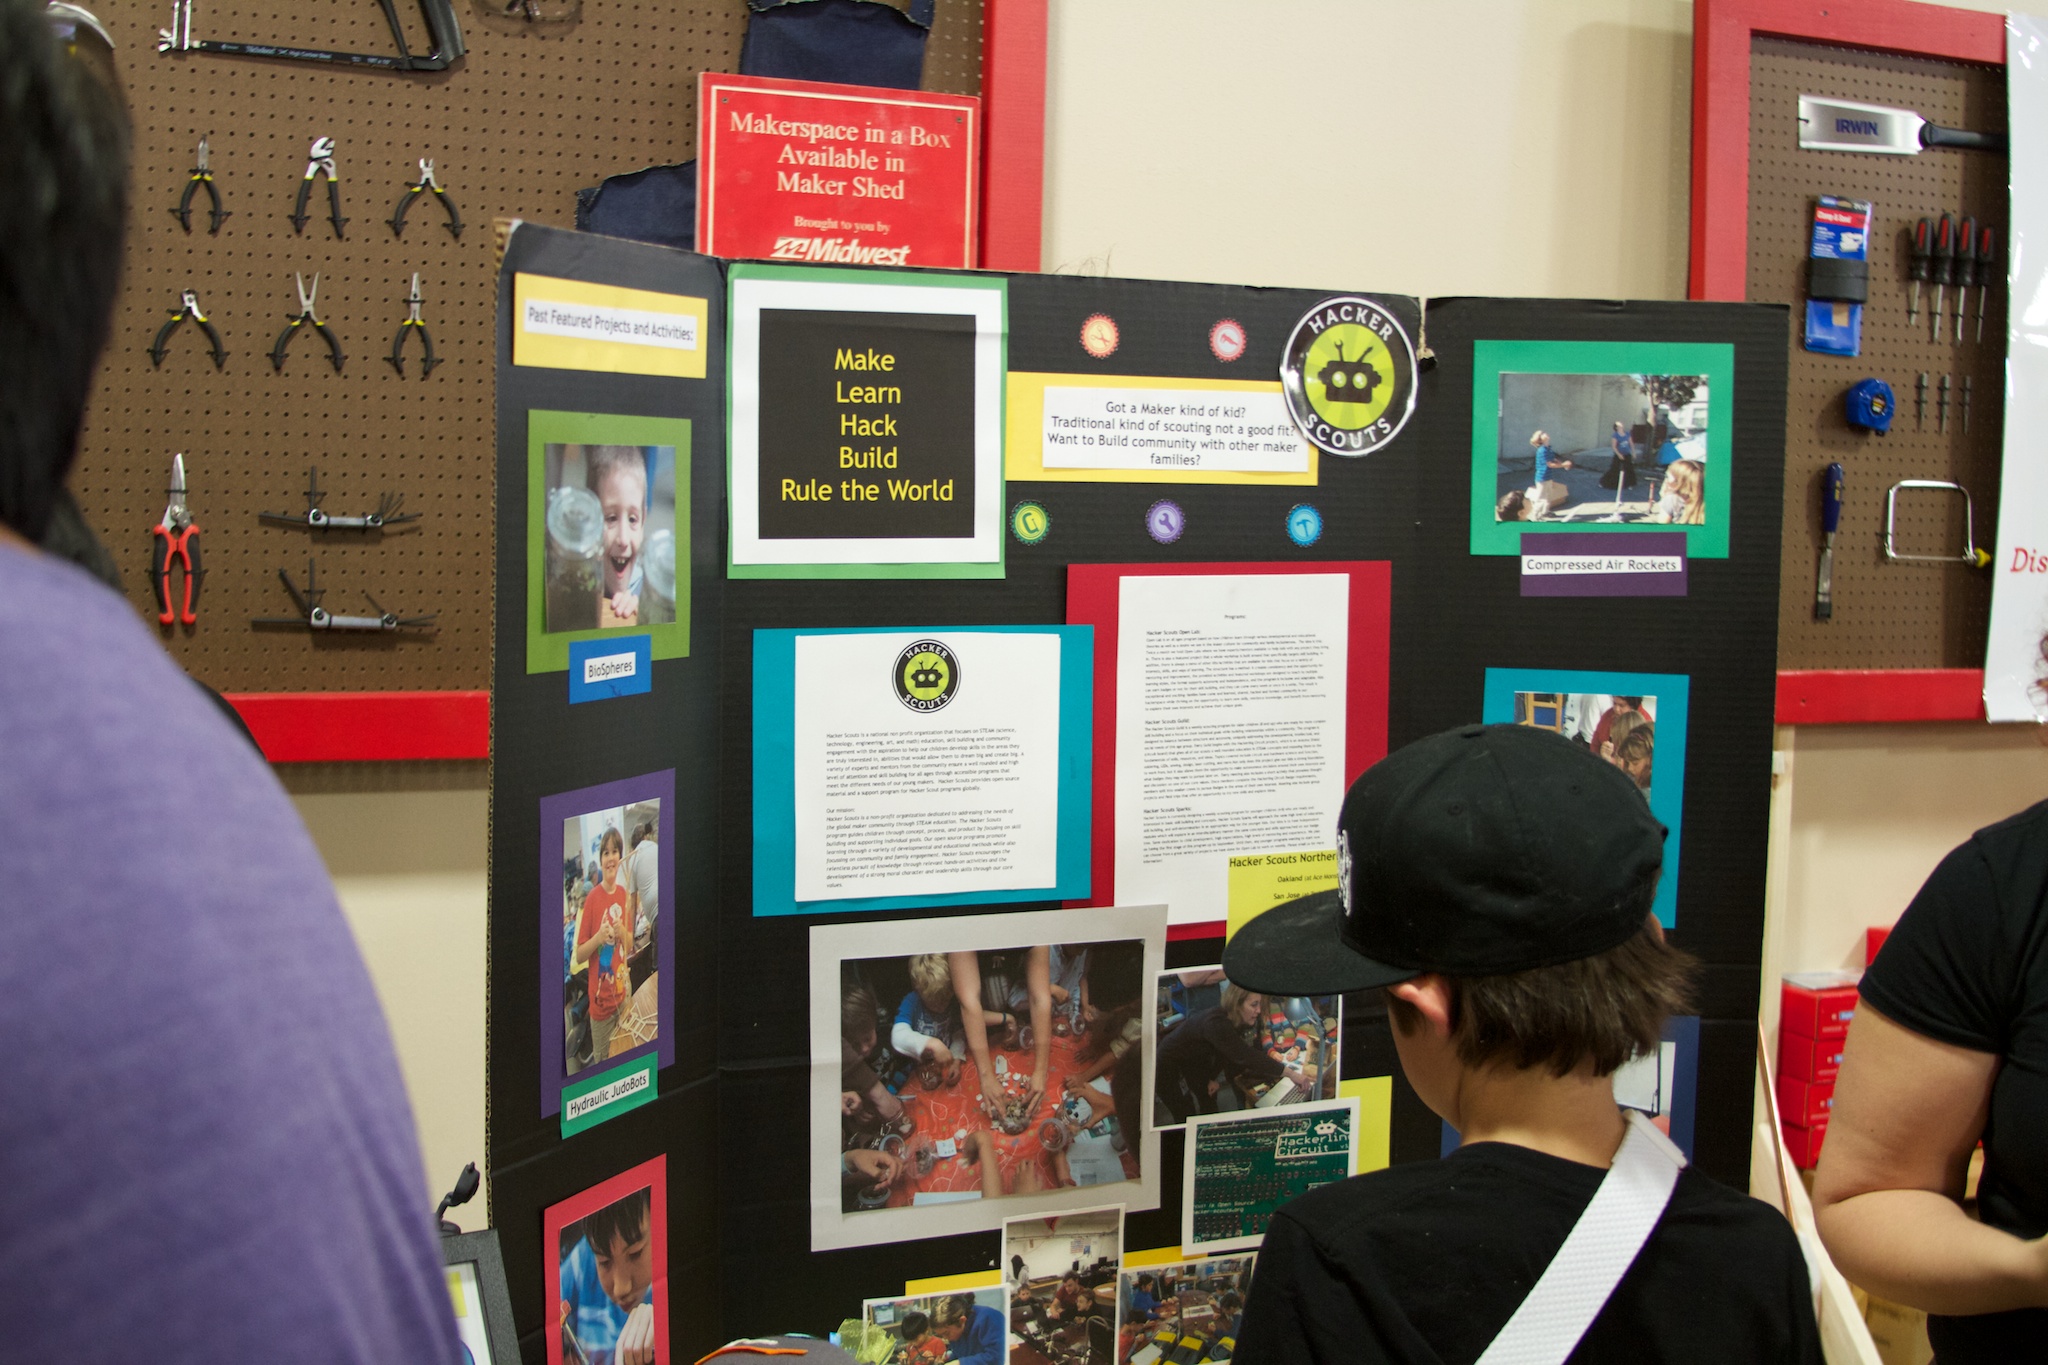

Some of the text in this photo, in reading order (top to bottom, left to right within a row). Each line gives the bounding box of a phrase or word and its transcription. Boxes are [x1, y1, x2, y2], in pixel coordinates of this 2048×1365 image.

[730, 112, 950, 147] Makerspace in a Box
[1836, 118, 1878, 135] IRWIN
[776, 145, 904, 172] Available in
[776, 171, 904, 199] Maker Shed
[793, 215, 890, 234] Brought to you by
[804, 238, 911, 266] Midwest
[528, 306, 693, 340] Past Featured Projects and Activities:
[1308, 305, 1393, 341] HACKER
[834, 348, 895, 370] Make
[836, 381, 900, 403] Learn
[1105, 401, 1246, 417] Got a Maker kind of kid?
[840, 414, 897, 436] Hack
[1050, 415, 1297, 437] Traditional kind of scouting not a good fit?
[1304, 414, 1391, 448] SCOUTS
[1047, 433, 1297, 452] Want to Build community with other maker
[839, 446, 897, 468] Build
[1150, 453, 1200, 465] families?
[781, 478, 952, 500] Rule the World
[1526, 559, 1676, 572] Compressed Air Rockets
[2010, 546, 2048, 573] Dis
[905, 644, 948, 658] HACKER
[588, 662, 632, 678] BioSpheres
[904, 692, 948, 708] SCOUTS
[1229, 852, 1337, 867] Hacker Scouts Norther
[570, 1075, 646, 1115] Hydraulic JudoBots
[1278, 1144, 1328, 1156] Circuit
[1280, 1132, 1349, 1146] Hackerlin
